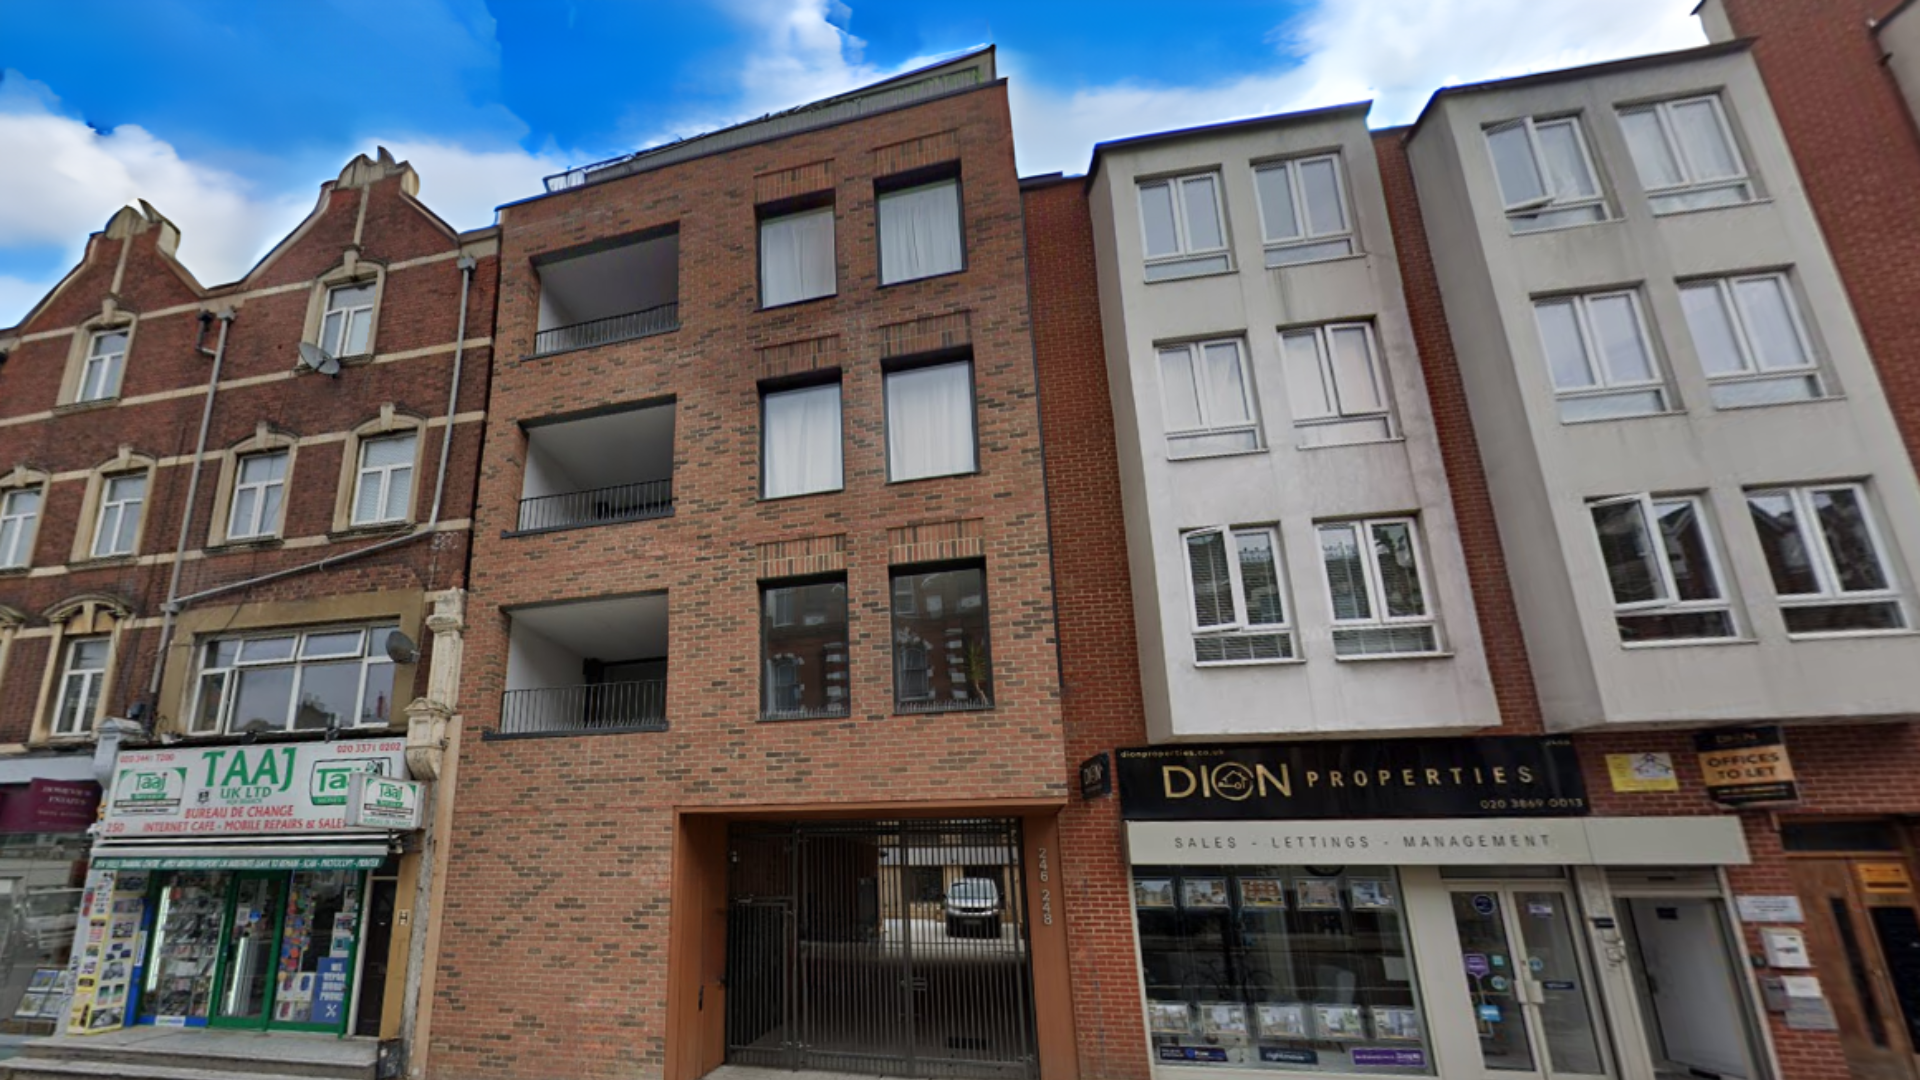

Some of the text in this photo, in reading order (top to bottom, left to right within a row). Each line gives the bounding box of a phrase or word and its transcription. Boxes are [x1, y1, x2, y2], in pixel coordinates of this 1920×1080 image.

[337, 745, 353, 753] 020
[1120, 749, 1224, 758] dionproperties.co.uk
[1707, 752, 1779, 767] OFFICES
[202, 747, 296, 792] TAAJ
[1718, 766, 1776, 779] TO LET
[136, 772, 168, 790] Taaj
[1162, 762, 1533, 801] DION PROPERTIES
[220, 787, 272, 799] UK LTD
[379, 783, 402, 800] Taaj
[1480, 799, 1506, 809] 020
[1548, 798, 1583, 808] 0013
[185, 804, 294, 819] BUREAU DE CHANGE
[143, 821, 189, 832] INTERNET
[190, 821, 215, 831] CAFE
[223, 820, 260, 832] MOBILE
[264, 819, 303, 830] REPAIRS
[1174, 836, 1236, 849] SALES
[1271, 836, 1369, 849] LETTINGS
[1403, 834, 1550, 848] MANAGEMENT
[1038, 848, 1049, 882] 246
[1042, 889, 1053, 925] 248
